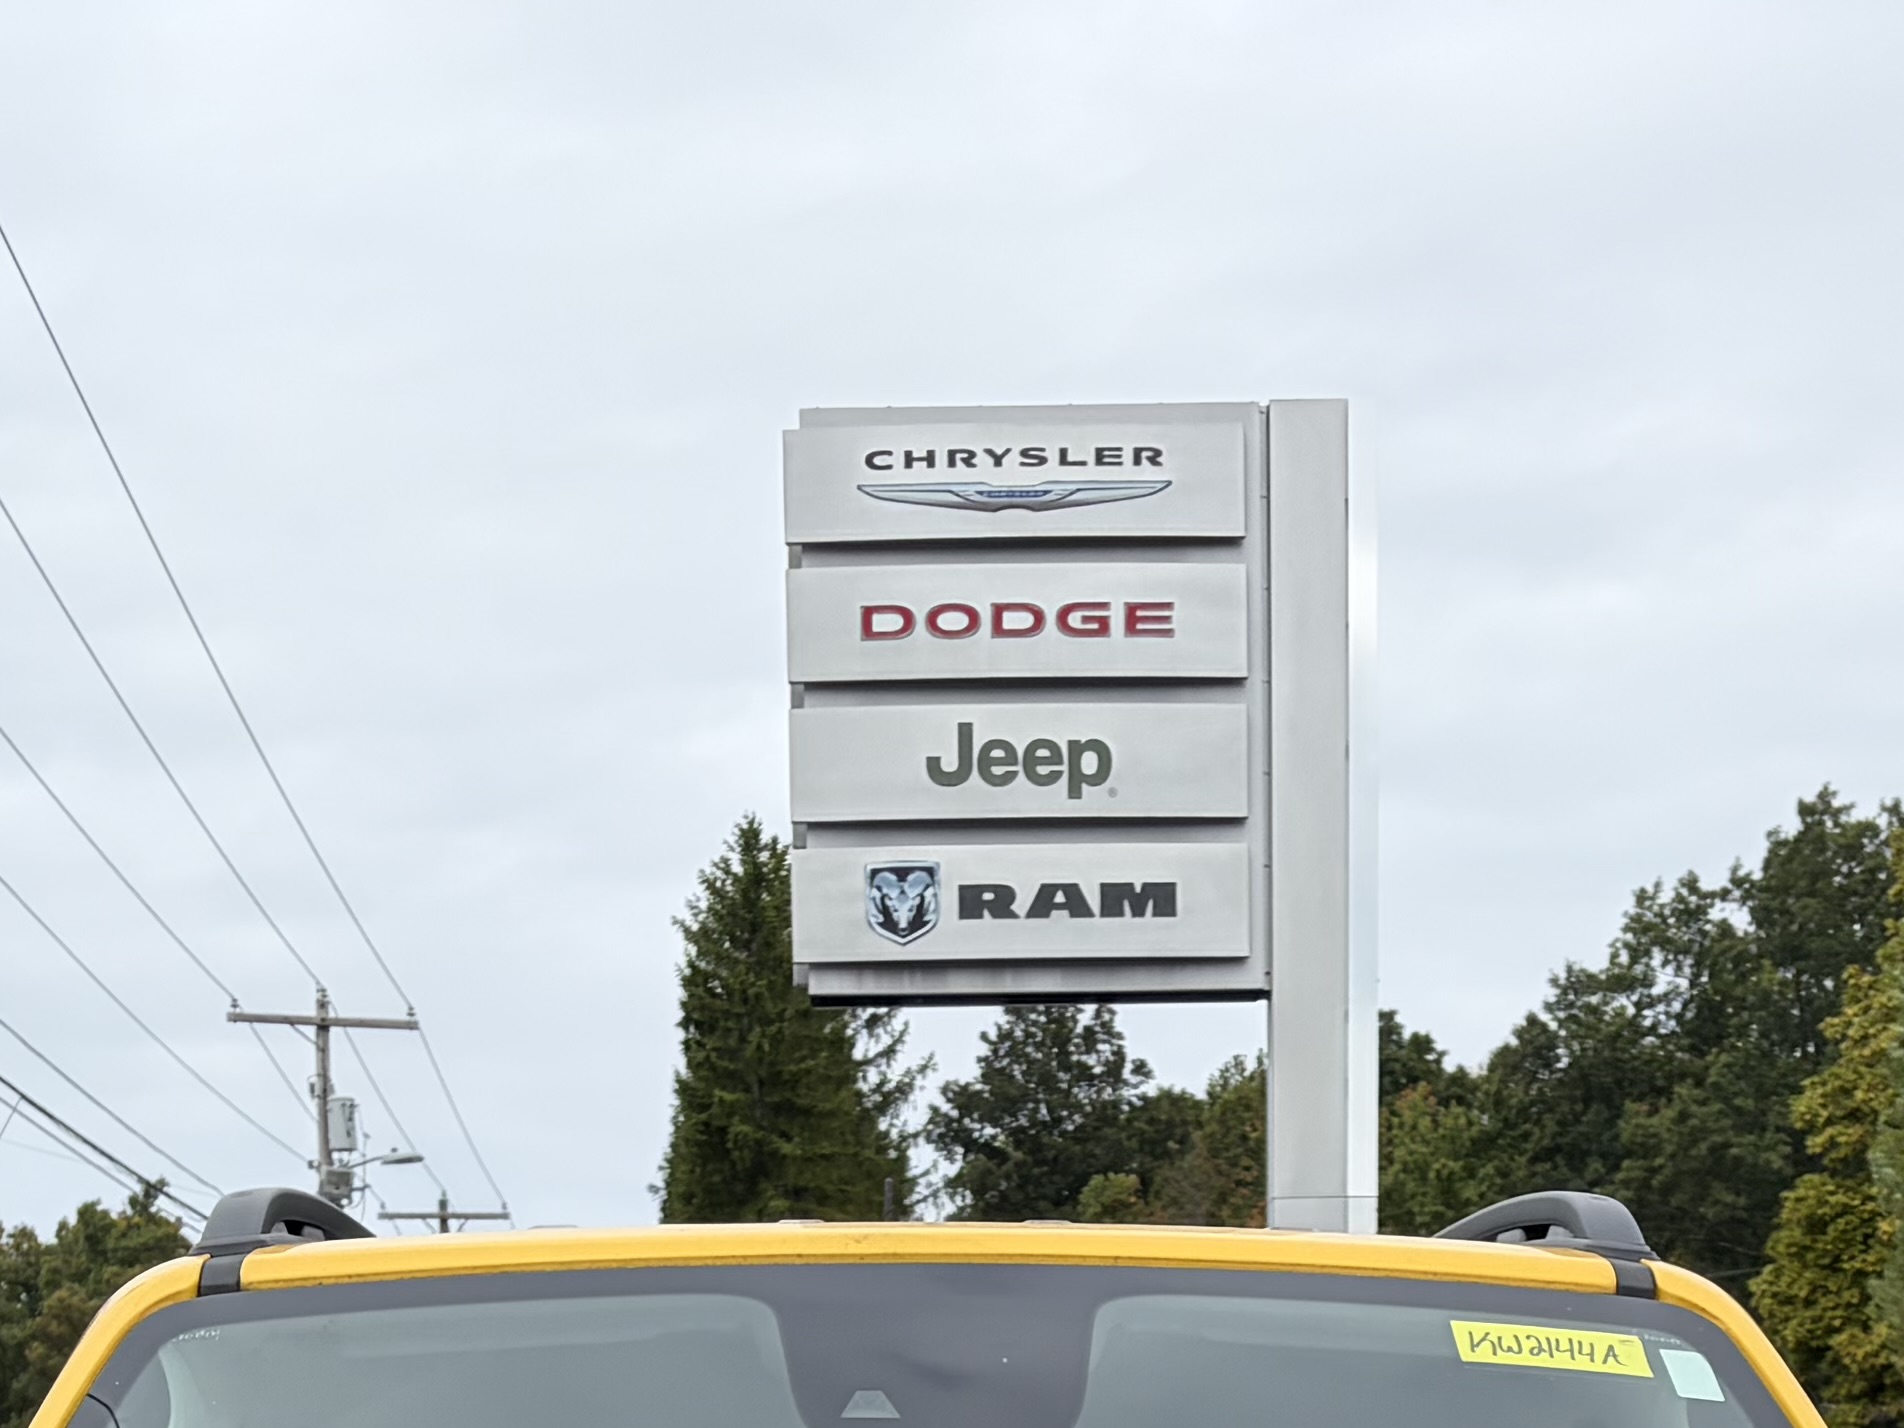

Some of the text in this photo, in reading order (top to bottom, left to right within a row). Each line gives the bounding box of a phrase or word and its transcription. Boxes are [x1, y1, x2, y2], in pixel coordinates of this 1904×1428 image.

[863, 446, 1164, 471] CHRYSLER
[859, 601, 1176, 642] DODGE
[925, 721, 1113, 800] Jeep
[957, 881, 1178, 921] RAM
